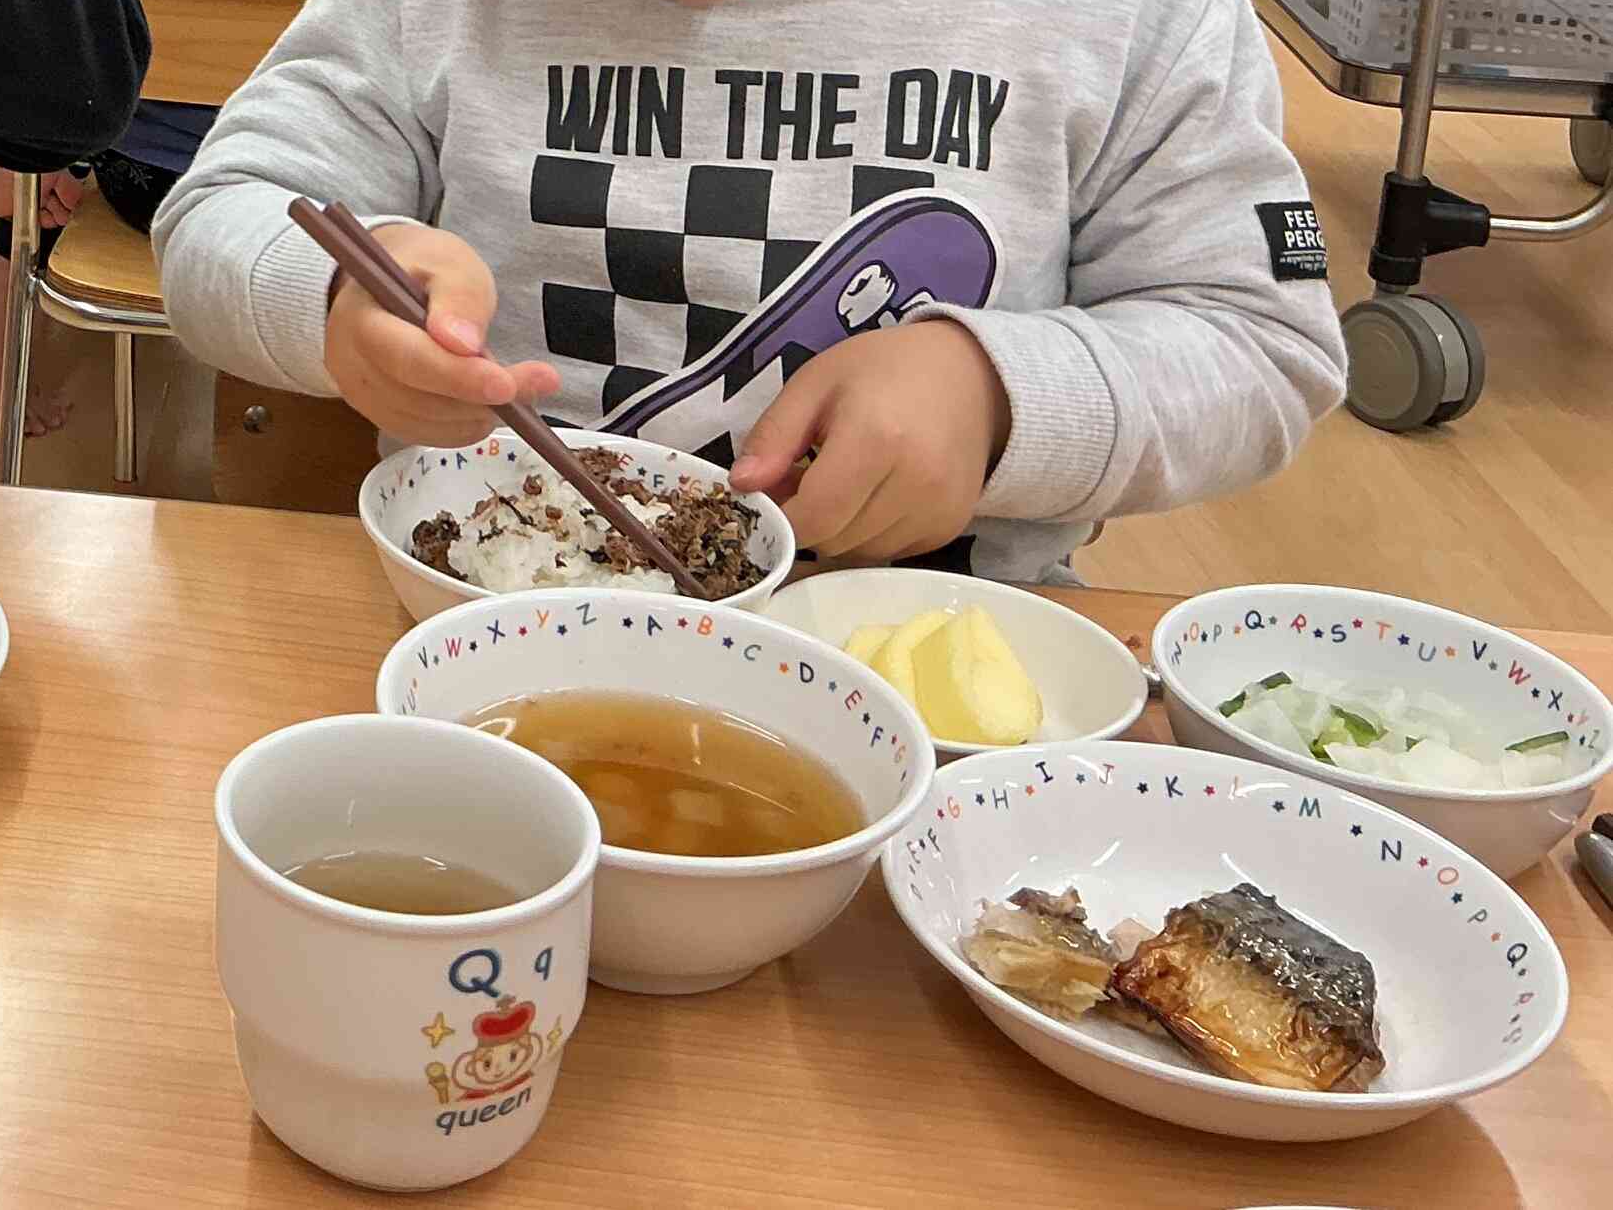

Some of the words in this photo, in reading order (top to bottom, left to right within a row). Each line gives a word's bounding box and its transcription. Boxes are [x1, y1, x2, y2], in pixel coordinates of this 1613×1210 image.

[546, 65, 685, 158] WIN
[715, 69, 859, 161] THE
[885, 68, 1010, 172] DAY
[1284, 210, 1321, 228] FEE
[416, 455, 431, 476] Z
[456, 452, 468, 470] A
[489, 439, 500, 456] B
[418, 646, 428, 669] V
[445, 637, 462, 658] W
[487, 619, 506, 644] X
[537, 610, 549, 628] Y
[576, 603, 597, 625] Z
[648, 615, 663, 636] A
[697, 615, 713, 636] B
[743, 644, 762, 661] C
[800, 661, 814, 683] D
[844, 689, 863, 711] E
[870, 726, 884, 748] F
[1244, 609, 1265, 630] Q
[1290, 613, 1307, 634] R
[1330, 624, 1347, 643] S
[1376, 621, 1392, 640] T
[1418, 642, 1436, 662] U
[1473, 640, 1488, 660] V
[1508, 660, 1531, 685] W
[1548, 689, 1563, 711] X
[927, 827, 941, 853] F
[947, 796, 960, 819] G
[992, 787, 1009, 809] H
[1035, 761, 1054, 783] I
[1165, 775, 1184, 798] K
[1298, 797, 1322, 819] M
[1381, 840, 1402, 861] N
[1437, 866, 1459, 885] O
[1467, 909, 1488, 923] P
[1507, 943, 1527, 968] Q
[449, 949, 501, 998] Q
[437, 1087, 533, 1136] queen
